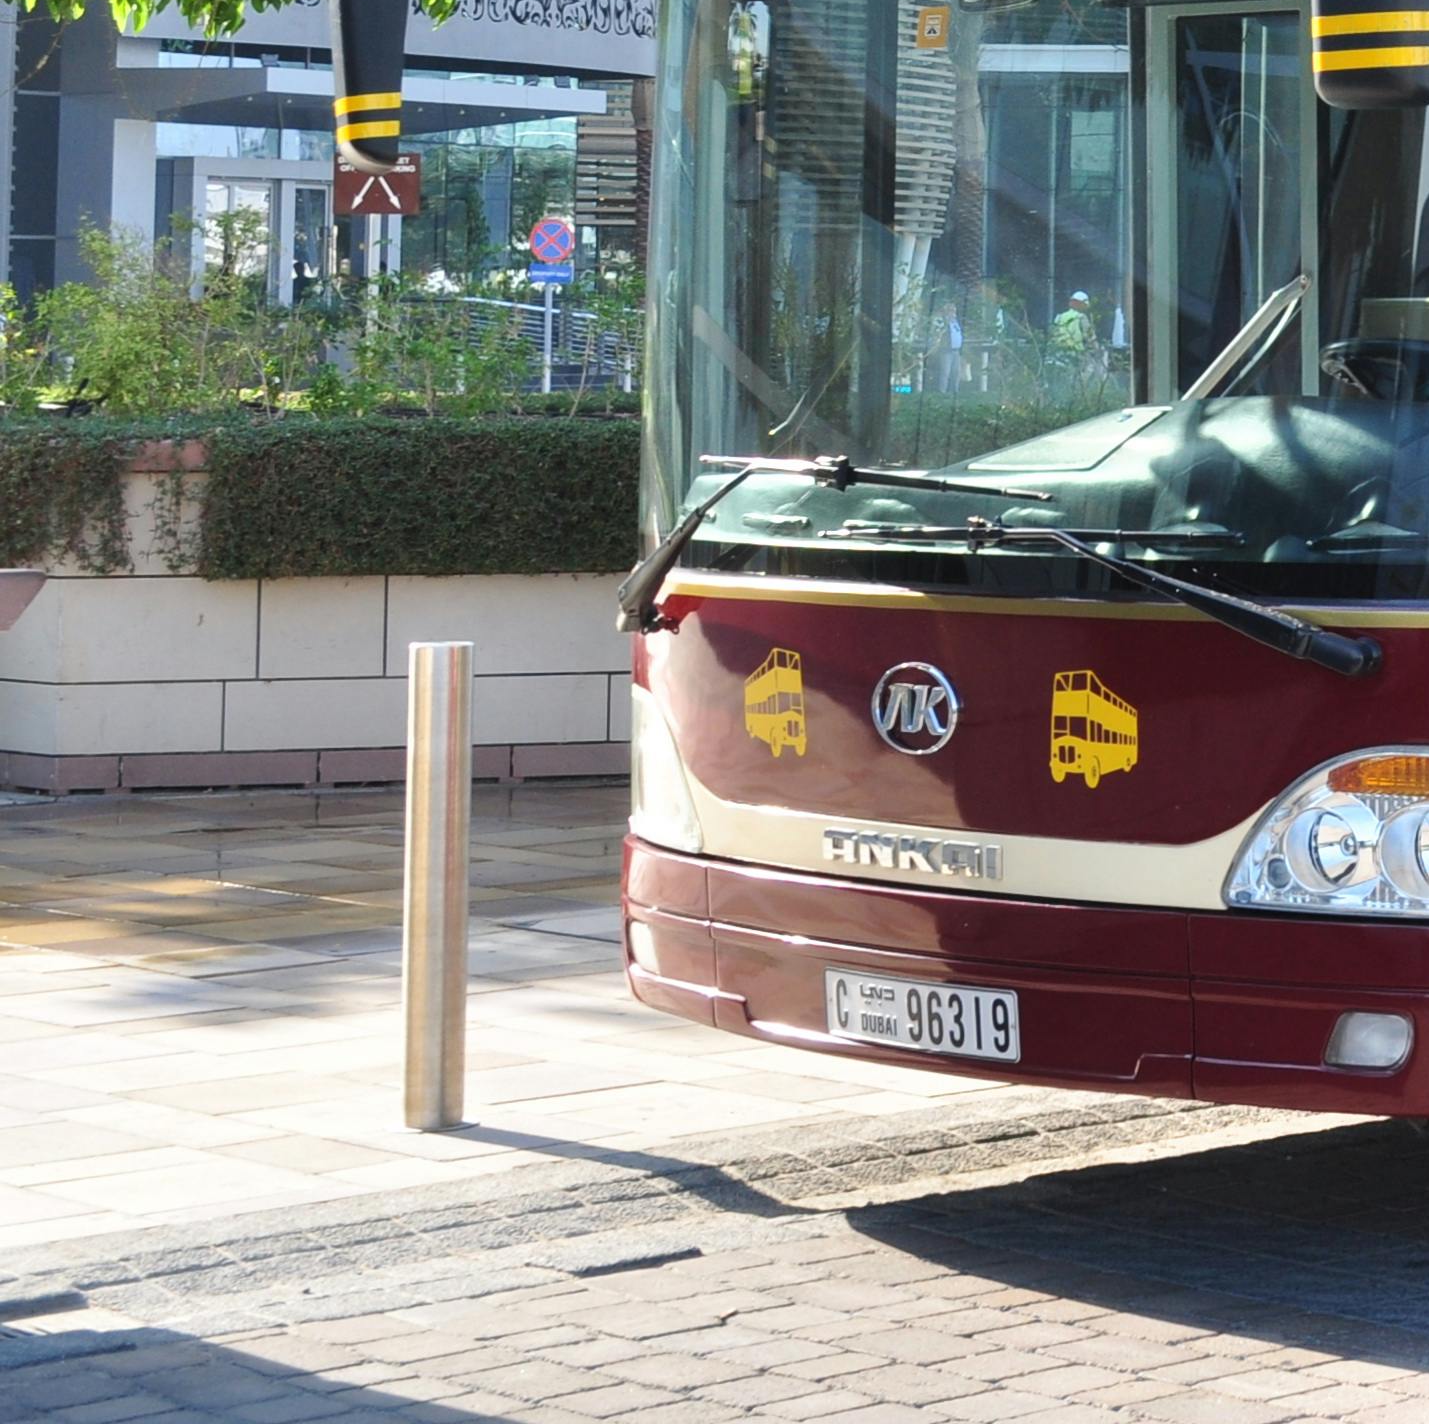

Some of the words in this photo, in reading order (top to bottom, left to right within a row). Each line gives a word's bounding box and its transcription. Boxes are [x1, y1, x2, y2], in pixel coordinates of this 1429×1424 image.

[823, 828, 1003, 880] ANKAI
[836, 978, 849, 1028] C
[860, 983, 896, 1006] دبي
[861, 1012, 898, 1037] DUBAI
[906, 987, 1011, 1053] 96319
